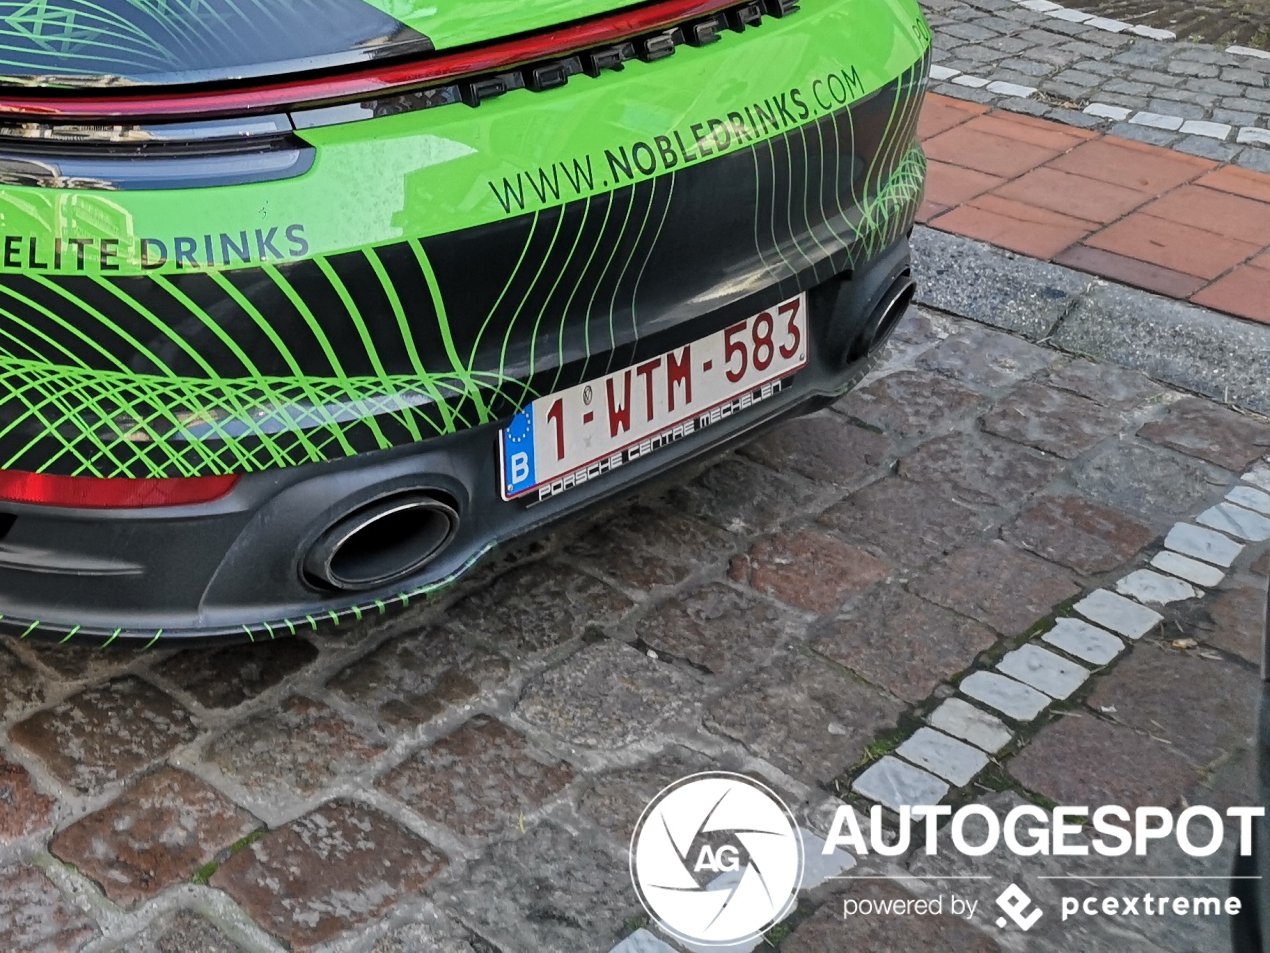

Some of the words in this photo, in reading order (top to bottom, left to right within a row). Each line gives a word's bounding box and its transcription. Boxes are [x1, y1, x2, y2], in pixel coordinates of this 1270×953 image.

[488, 64, 866, 215] WWW.NOBLEDRINKS.COM
[4, 235, 120, 271] ELITE
[140, 223, 310, 271] DRINKS
[511, 451, 530, 485] B
[538, 453, 623, 501] PORSCHE
[628, 424, 695, 460] CENTRE
[700, 380, 782, 427] MECHELEN
